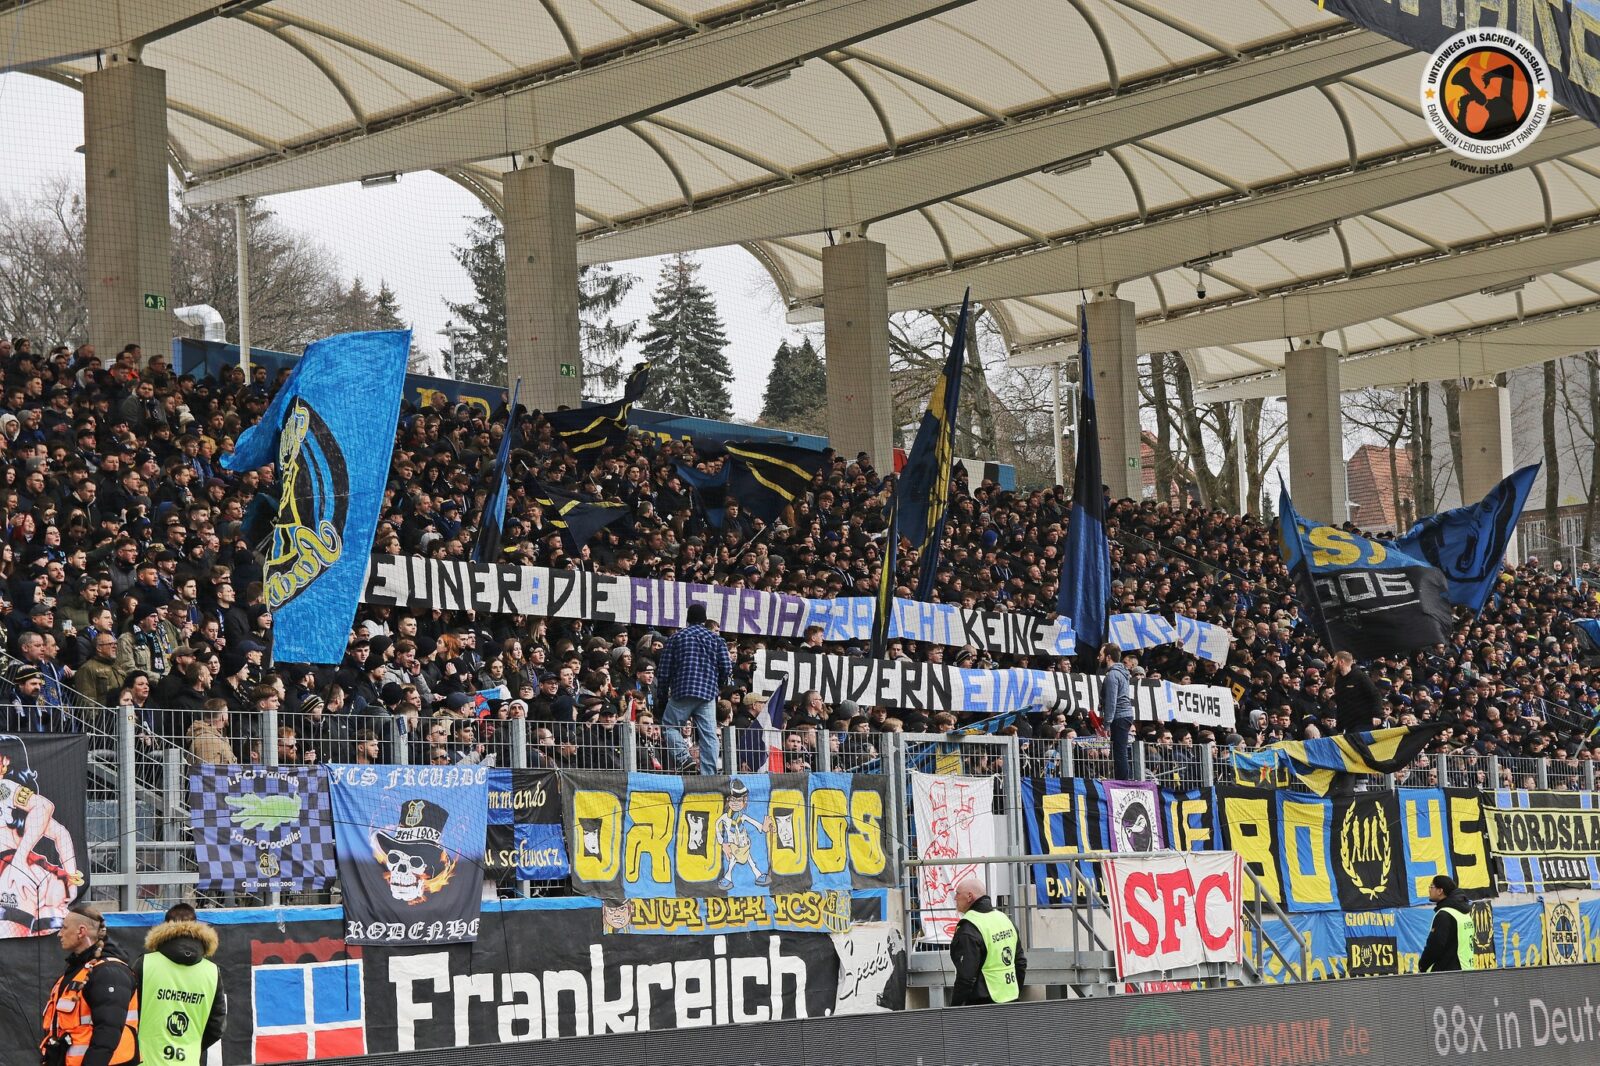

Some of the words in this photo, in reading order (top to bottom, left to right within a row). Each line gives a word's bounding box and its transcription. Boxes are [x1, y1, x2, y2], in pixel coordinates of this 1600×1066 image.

[548, 567, 617, 622] DIE
[630, 577, 806, 638] AUSTRIA
[959, 608, 1050, 656] KEINE
[761, 648, 953, 711] SONDERN
[959, 667, 1045, 712] EINE
[331, 767, 378, 787] FCS
[383, 767, 487, 790] FREUNDE
[231, 830, 302, 850] Saar-Crocodiles
[573, 788, 886, 884] DROOGS
[630, 897, 701, 931] NUR
[704, 896, 769, 931] DER
[773, 891, 822, 930] FCS
[1123, 868, 1234, 958] SFC
[157, 988, 205, 1005] SICHERHEIT
[1433, 1005, 1488, 1056] 88x
[1494, 997, 1522, 1050] in
[163, 1045, 185, 1062] 96
